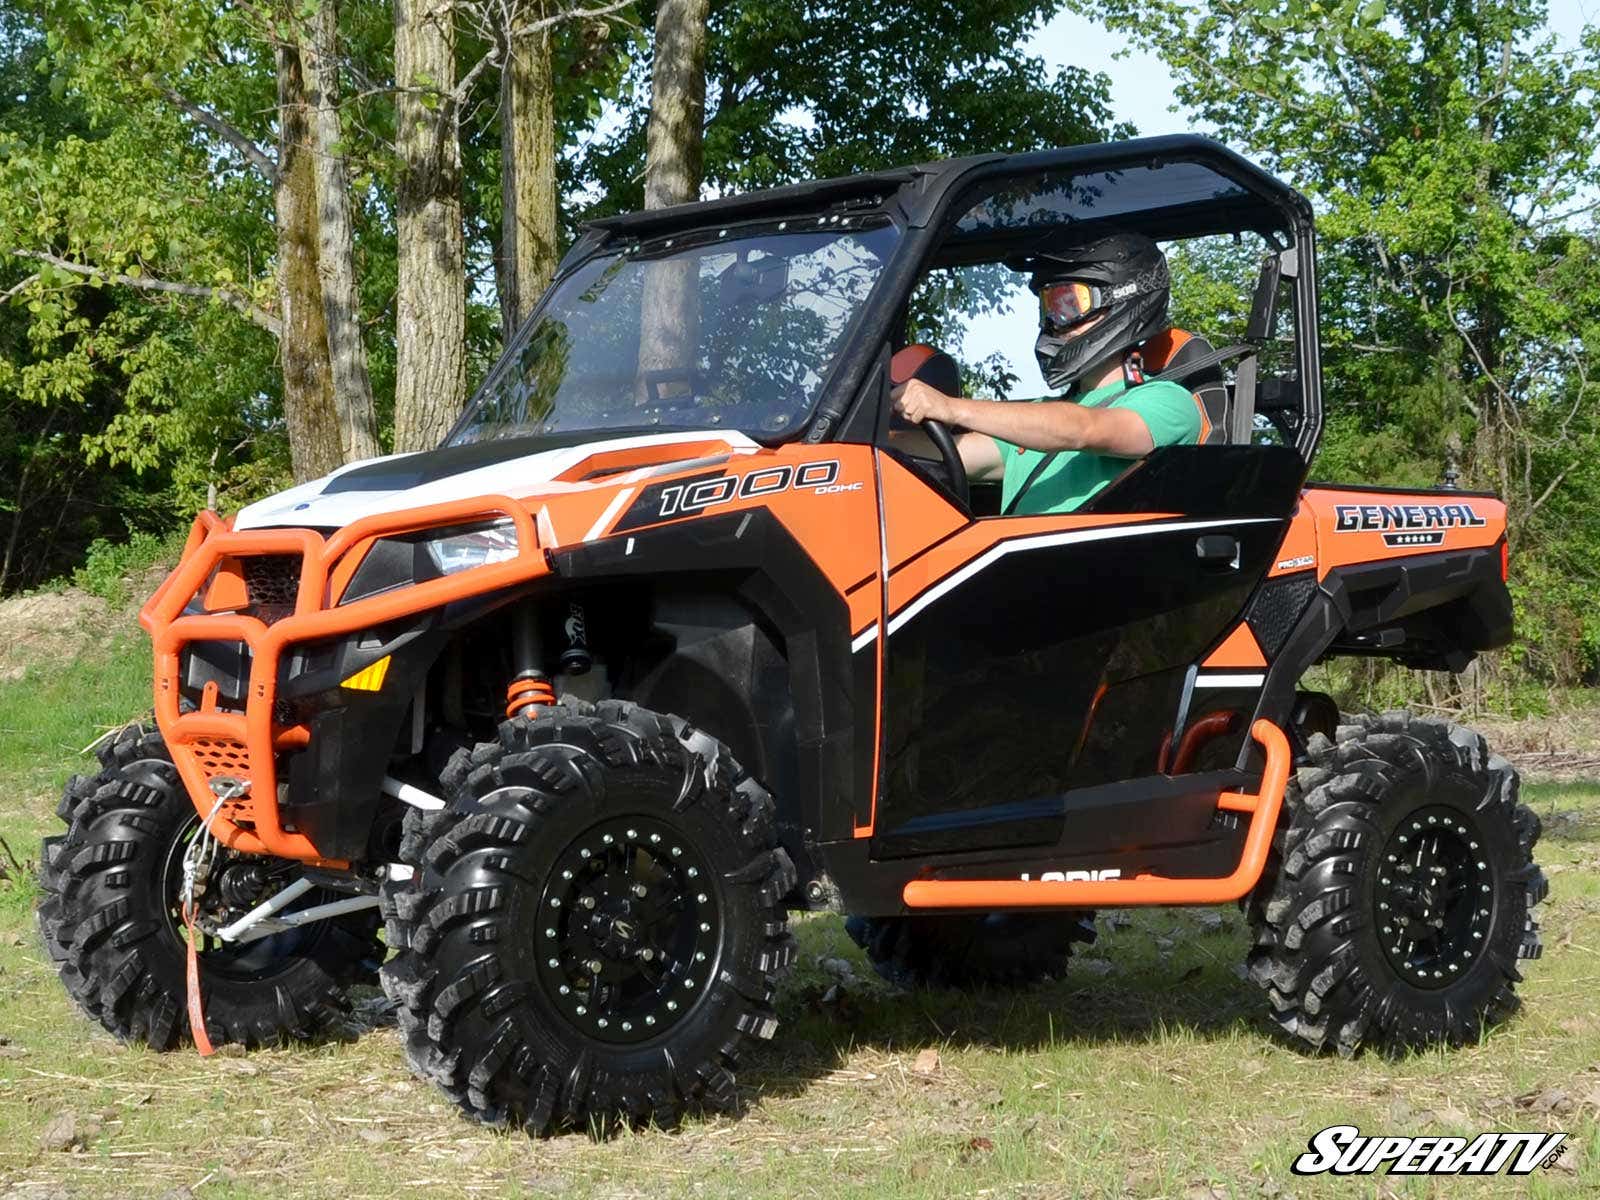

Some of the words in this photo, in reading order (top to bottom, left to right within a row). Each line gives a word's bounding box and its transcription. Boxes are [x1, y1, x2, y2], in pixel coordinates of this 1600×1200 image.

[659, 460, 840, 516] 1000
[815, 482, 864, 495] DOHC
[1333, 504, 1487, 533] GENERAL
